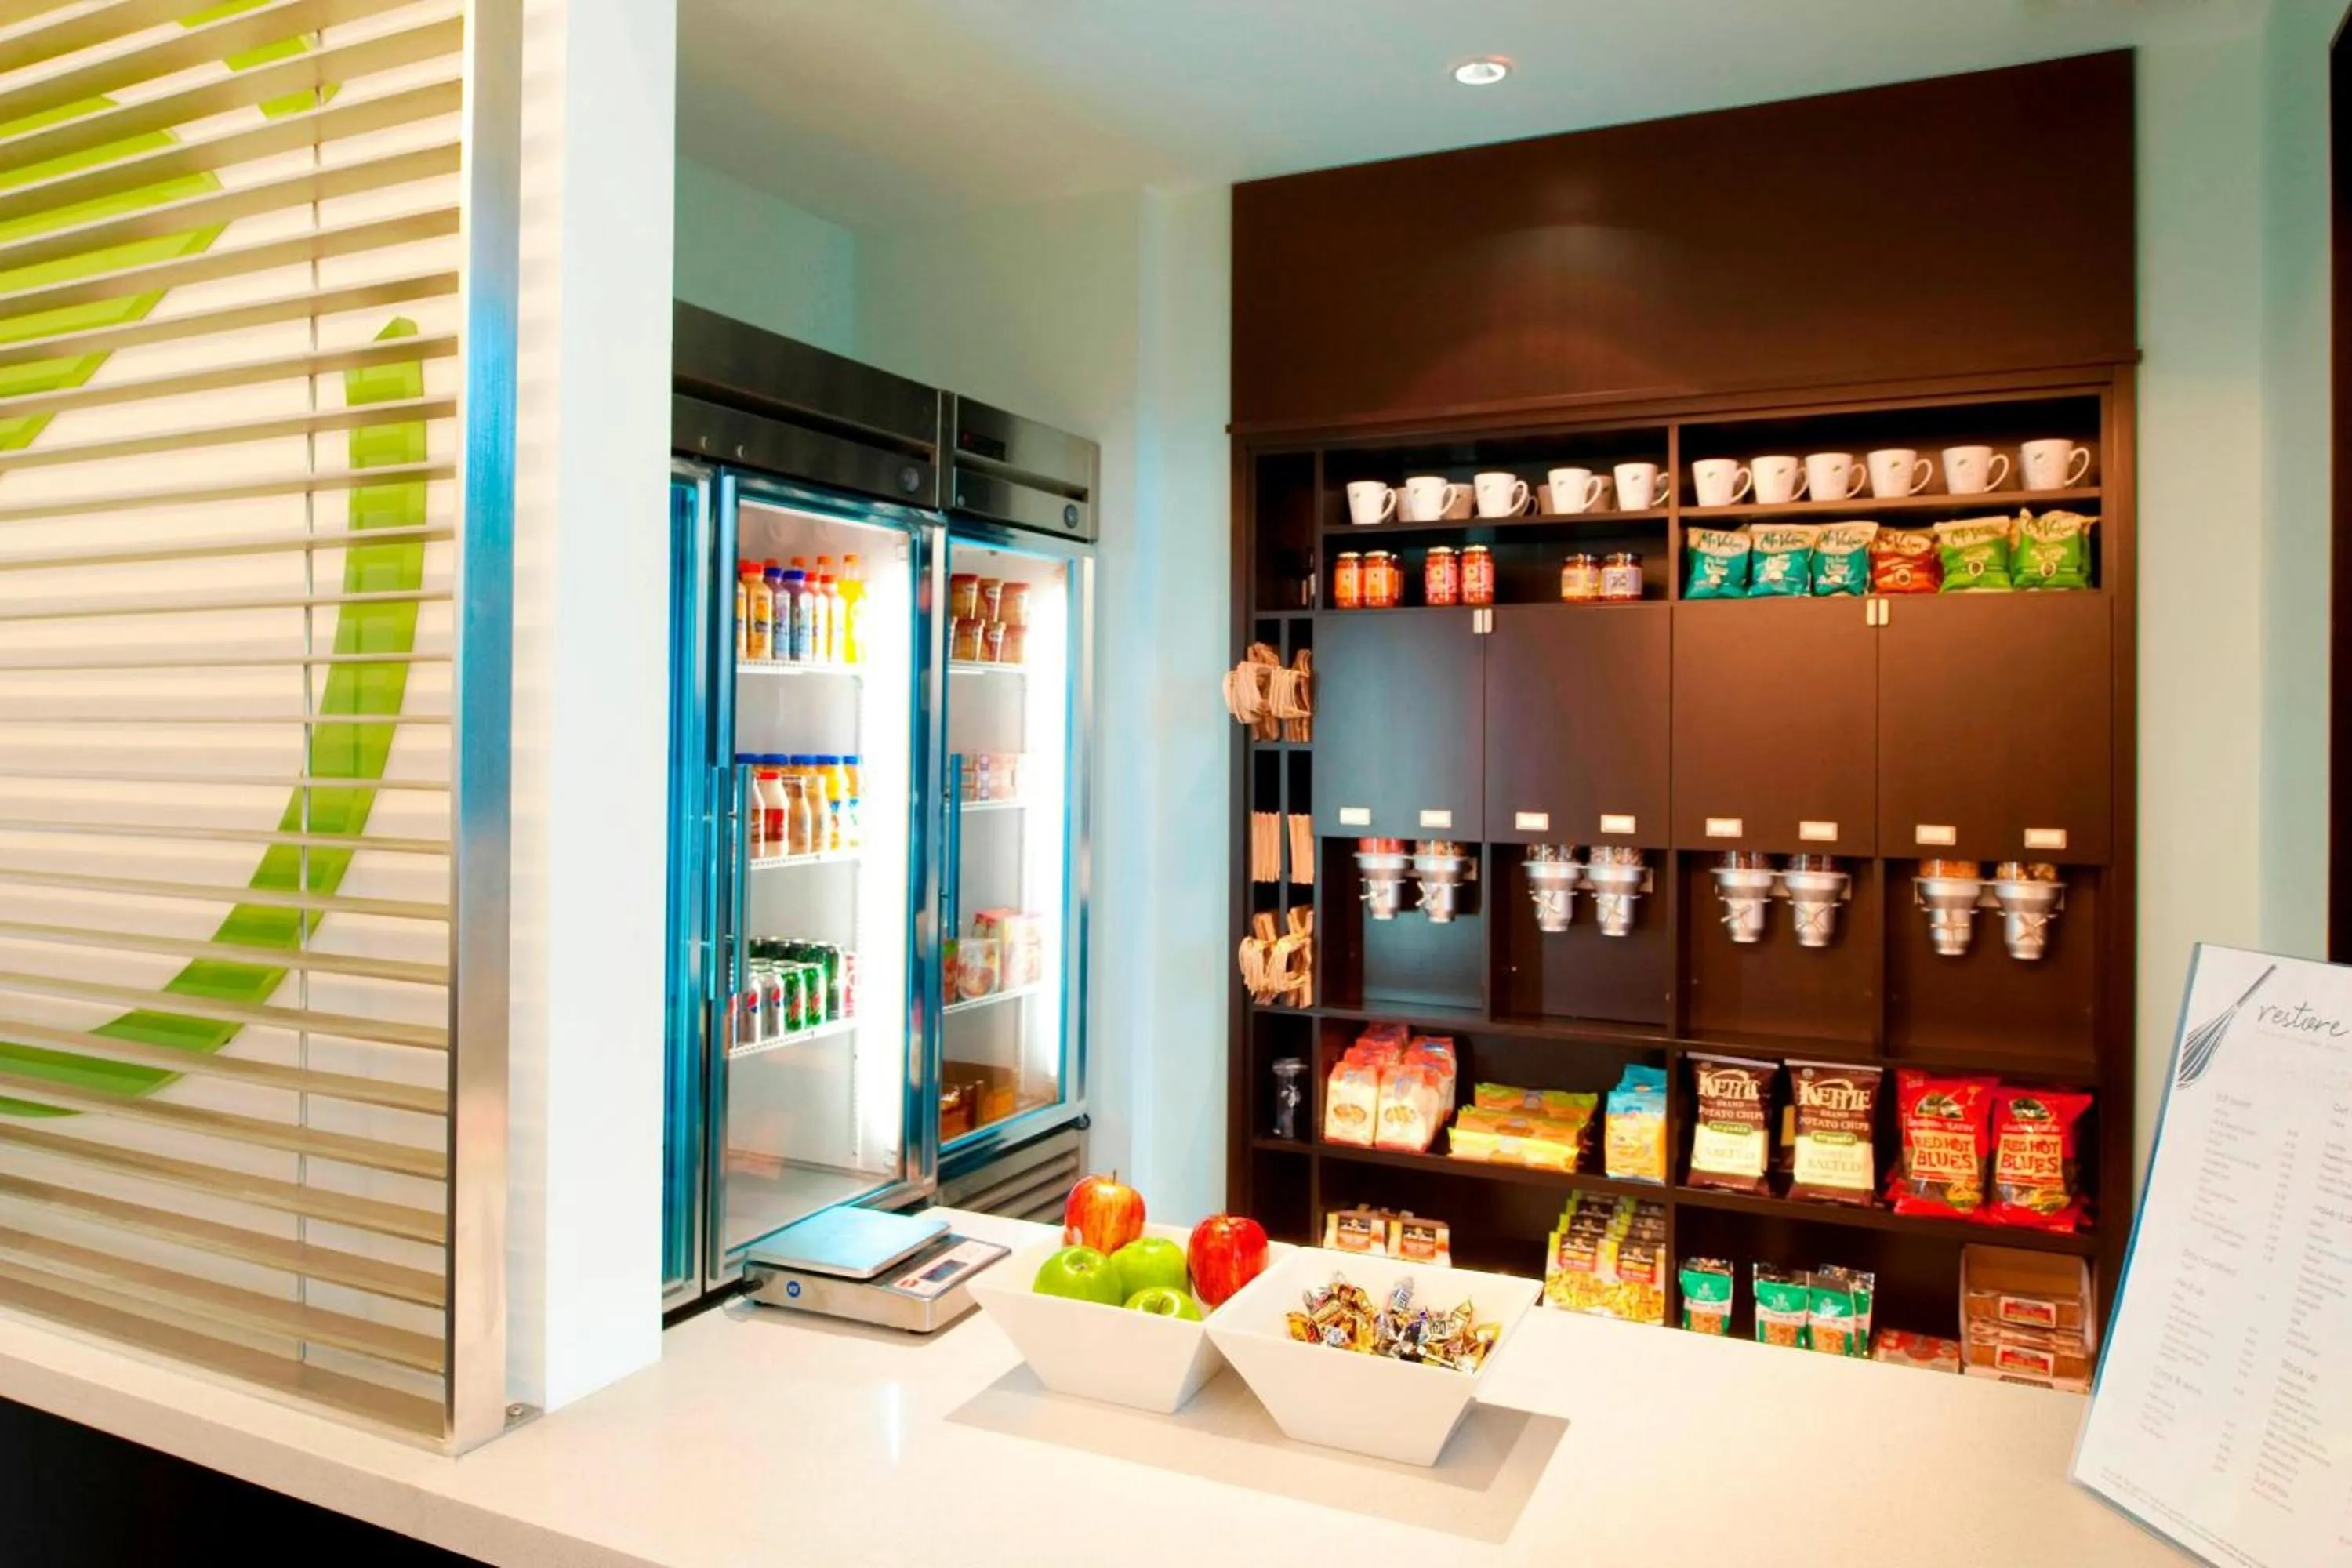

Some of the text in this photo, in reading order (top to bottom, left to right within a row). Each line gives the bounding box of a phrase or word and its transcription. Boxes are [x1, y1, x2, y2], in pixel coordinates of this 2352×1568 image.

[2257, 1001, 2350, 1037] restore
[1798, 1078, 1871, 1111] KETTLE
[1916, 1149, 1974, 1170] BLUES
[2001, 1152, 2059, 1174] BLUES
